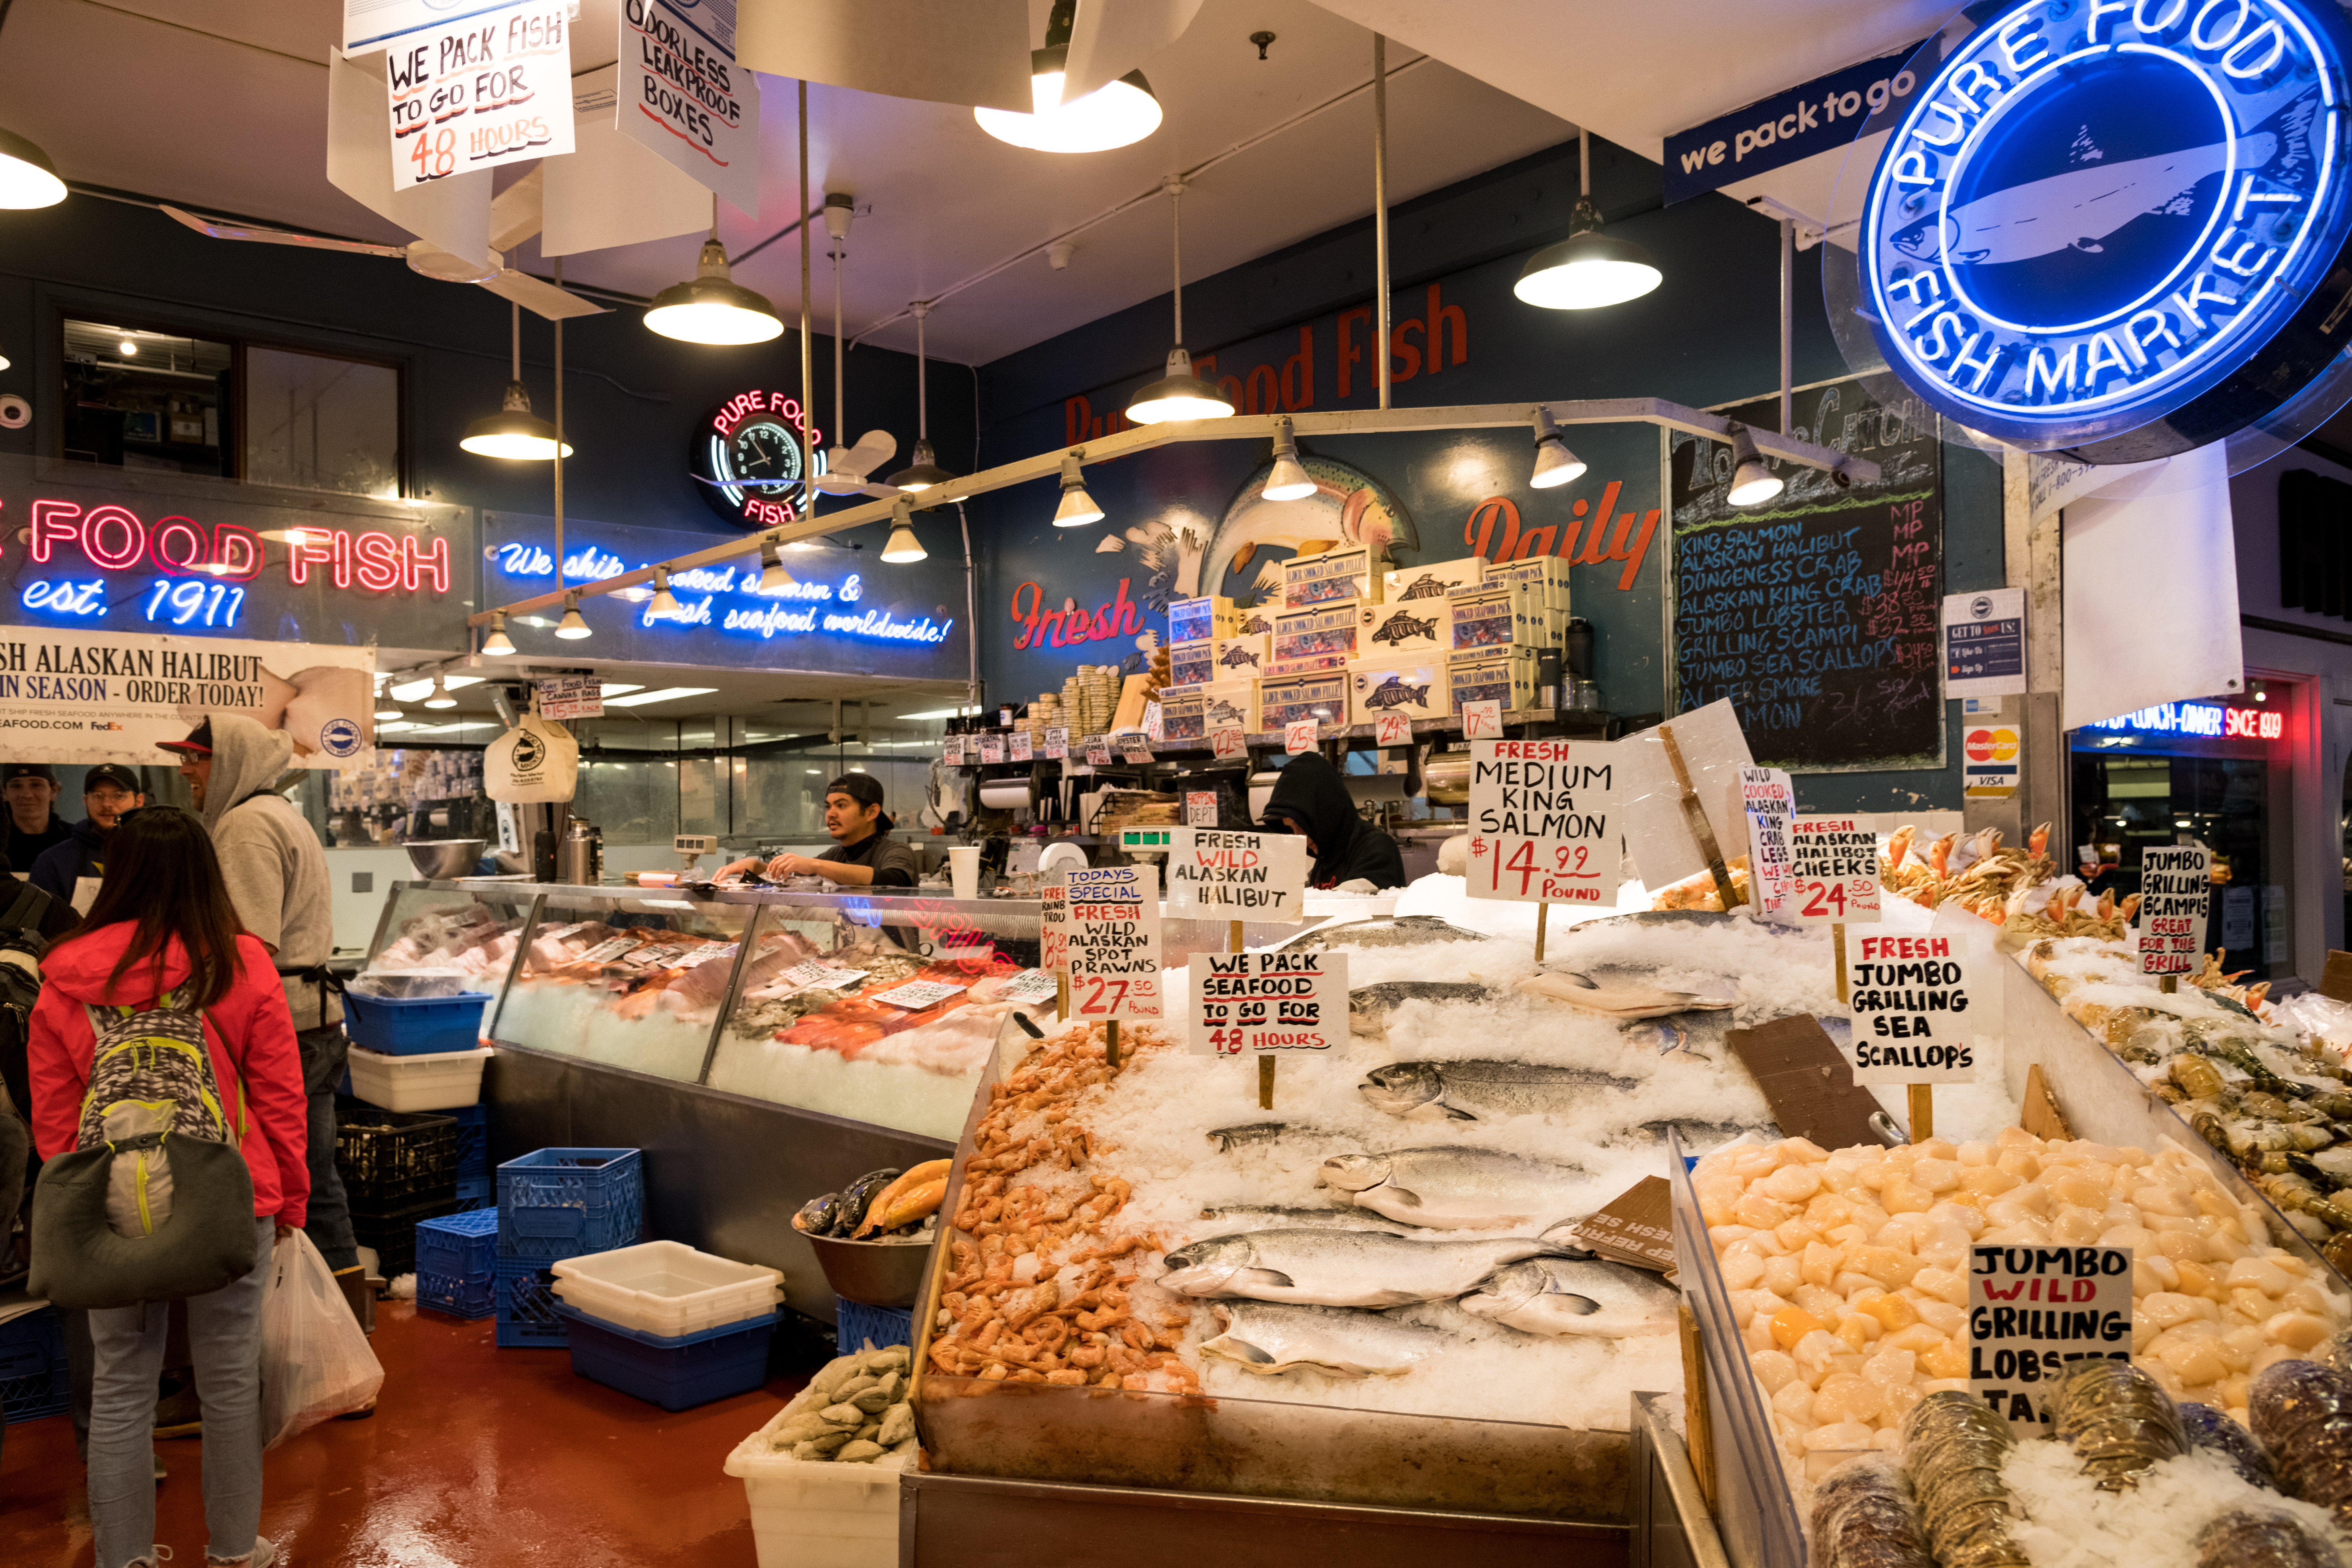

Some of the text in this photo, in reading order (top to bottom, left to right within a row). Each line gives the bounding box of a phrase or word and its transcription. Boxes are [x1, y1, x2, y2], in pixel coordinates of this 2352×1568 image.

[390, 12, 562, 90] WE PACK FISH
[626, 0, 730, 92] ODORLESS
[642, 36, 740, 120] LEAKPROOF
[393, 65, 528, 125] TO GO FOR
[1892, 14, 2049, 187] PURE
[644, 76, 713, 146] BOXES
[1681, 69, 1916, 174] we pack to go
[411, 116, 548, 176] 48 HOURS
[1889, 176, 2301, 397] FISH MARKET
[1338, 283, 1466, 397] Fish
[714, 390, 766, 435] PURE
[745, 500, 795, 524] FISH
[1681, 501, 1923, 555] KING SALMON MP
[32, 500, 264, 582] FOOD
[289, 527, 449, 593] FISH
[1681, 520, 1923, 573] ALASKAN HALIBUT MP
[501, 542, 553, 576] We
[840, 574, 860, 601] &
[1011, 481, 1661, 650] Fresh Daily
[1304, 563, 1323, 578] SMOKED
[1324, 560, 1345, 575] SALMON
[1346, 556, 1365, 572] FILLET
[1681, 561, 1792, 596] DUNGENESS
[1797, 551, 1862, 578] CRAB
[23, 579, 244, 627] est. 1911
[1680, 575, 1881, 615] ALASKAN KING CRAB
[1294, 616, 1313, 631] SMOKED
[1314, 613, 1336, 628] SALMON
[1337, 609, 1356, 625] FILLET
[1453, 599, 1511, 619] SMOKED SEAFOOD PACK
[1678, 611, 1744, 635] JUMBO
[1753, 601, 1849, 628] LOBSTER
[724, 602, 952, 642] seafood worldwide!
[1952, 626, 1968, 638] GET
[1970, 625, 1981, 636] TO
[1679, 624, 1857, 662] GRILLING SCAMPI
[35, 645, 153, 678] ALASKAN
[162, 652, 262, 683] HALIBUT
[1681, 636, 1900, 684] JUMBO SEA SCALLOPS
[1451, 663, 1510, 683] SMOKED SEAFOOD PACK
[0, 675, 264, 708] IN SEASON ORDER TODAY!
[547, 692, 577, 700] CANVAS
[1280, 687, 1300, 701] SMOKED
[1302, 684, 1321, 699] SALMON
[1323, 681, 1343, 698] FILLET
[91, 722, 123, 731] FedEx
[2225, 707, 2281, 738] SINCE 1909
[1495, 742, 1569, 761] FRESH
[1967, 742, 2016, 750] MasterCard
[1476, 761, 1611, 791] MEDIUM
[1744, 769, 1770, 782] WILD
[1980, 777, 2003, 785] VISA
[1503, 787, 1574, 811] KING
[1744, 784, 1784, 799] COOKED
[1190, 807, 1214, 823] DEPT.
[1746, 799, 1788, 813] ALASKAN
[1481, 809, 1605, 839] SALMON
[1757, 816, 1782, 830] KING
[1792, 821, 1854, 834] FRESH
[1195, 833, 1260, 848] FRESH
[1760, 831, 1784, 846] CRAB
[1793, 832, 1876, 846] ALASKAN
[1196, 850, 1258, 868] WILD
[1761, 846, 1788, 863] LEGS
[2144, 851, 2204, 873] JUMBO
[1068, 869, 1134, 882] TODAYS
[1176, 865, 1267, 883] ALASKAN
[1762, 865, 1780, 877] WE
[1070, 885, 1141, 900] SPECIAL
[1543, 879, 1600, 901] POUND
[2144, 873, 2210, 895] GRILLING
[1199, 887, 1286, 908] HALIBUT
[1851, 898, 1880, 910] POUND
[2144, 896, 2208, 918] SCAMPIS
[1075, 905, 1140, 920] FRESH
[1086, 922, 1135, 936] WILD
[2151, 918, 2192, 933] GREAT
[1068, 935, 1148, 948] ALASKAN
[1862, 937, 1949, 961] FRESH
[2139, 937, 2195, 950] FOR THE
[1085, 948, 1133, 961] SPOT
[1210, 954, 1318, 973] WE PACK
[2144, 954, 2191, 971] GRILL
[1072, 959, 1157, 975] PRAWNS
[1853, 961, 1962, 987] JUMBO
[1204, 978, 1312, 996] SEAFOOD
[1129, 1001, 1159, 1015] POUND
[1204, 1001, 1319, 1018] TO GO FOR
[1853, 989, 1968, 1013] GRILLING
[1874, 1016, 1932, 1038] SEA
[1210, 1028, 1324, 1053] 48 HOURS
[1972, 1247, 2127, 1277] JUMBO
[1982, 1279, 2096, 1302] WILD
[1971, 1306, 2131, 1341] GRILLING
